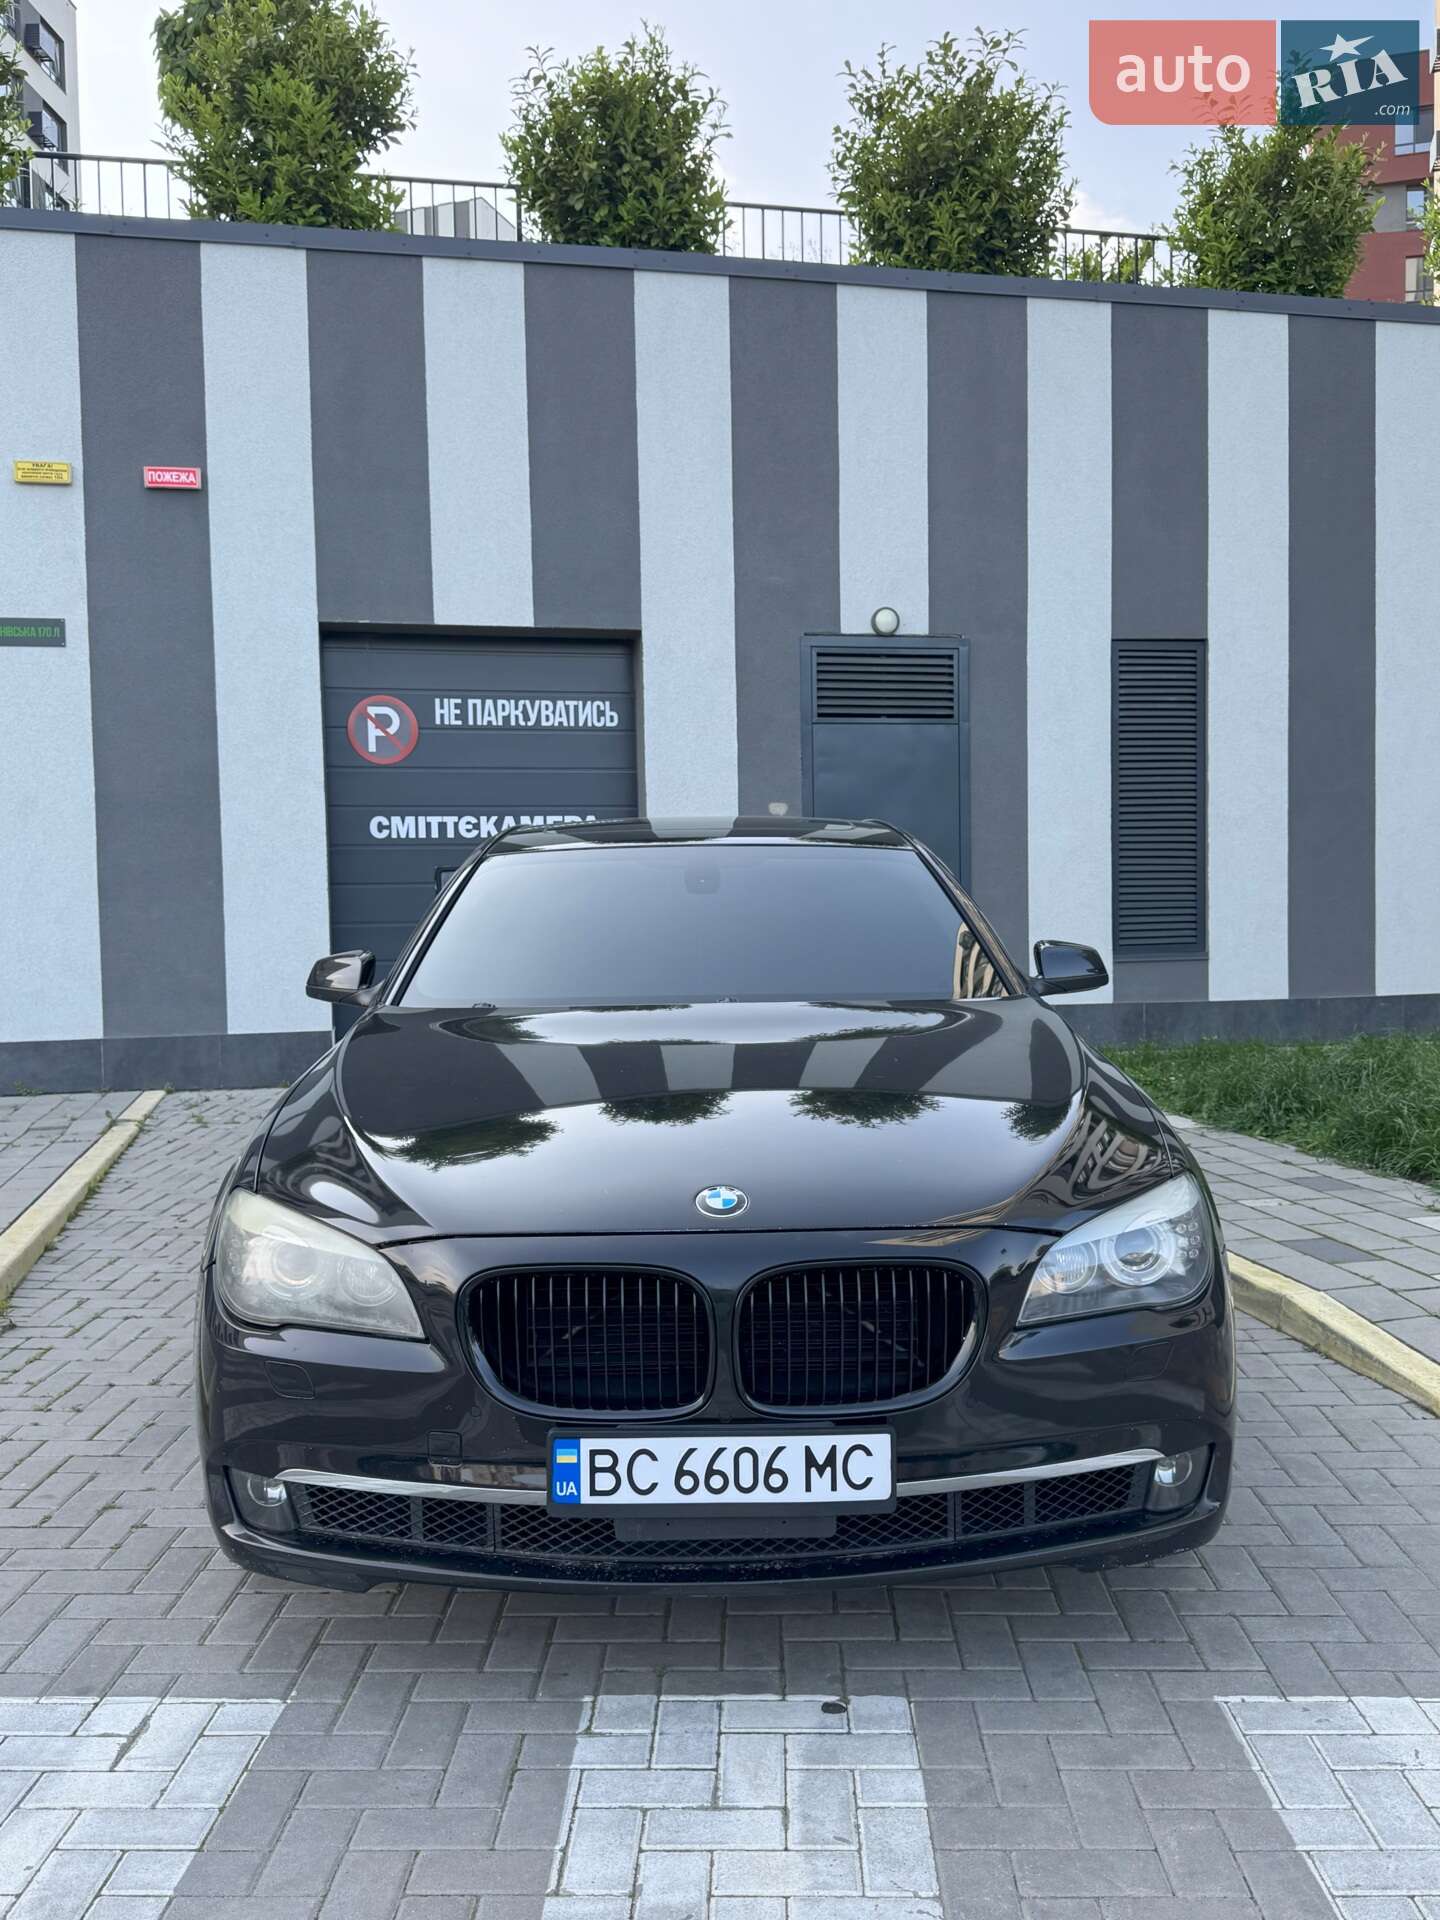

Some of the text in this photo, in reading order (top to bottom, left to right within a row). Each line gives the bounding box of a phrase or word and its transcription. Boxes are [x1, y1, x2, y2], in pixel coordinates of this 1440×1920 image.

[148, 471, 196, 483] ПОЖЕЖА
[434, 698, 619, 727] НЕ ПАРКУВАТИСЬ
[589, 1443, 874, 1497] BC 6606 MC
[556, 1481, 578, 1496] UA
